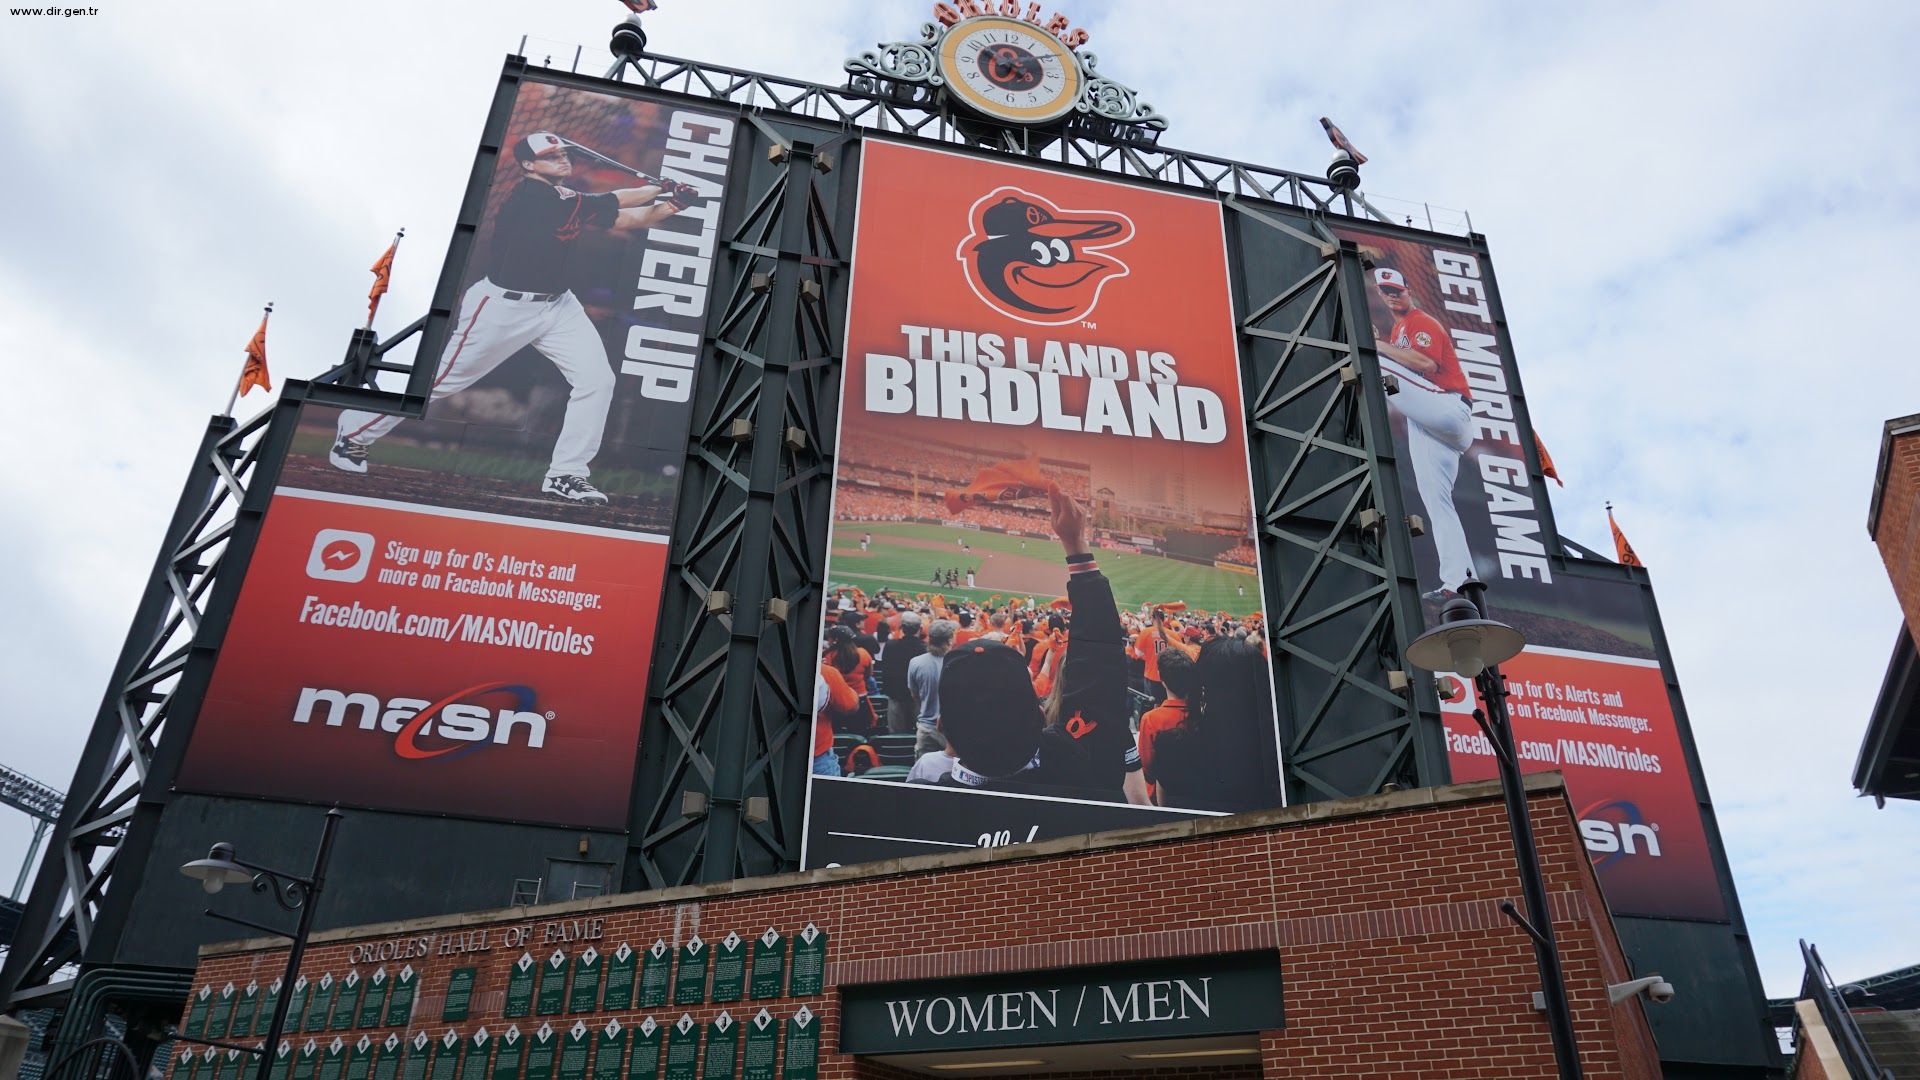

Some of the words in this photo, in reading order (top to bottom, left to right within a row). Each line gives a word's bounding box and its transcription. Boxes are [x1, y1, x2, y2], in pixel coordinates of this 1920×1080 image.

[933, 0, 1089, 49] ORIOLES
[633, 110, 735, 318] CHATTER
[1432, 248, 1493, 324] GET
[1081, 320, 1097, 329] TM
[620, 324, 700, 403] UP
[900, 324, 1006, 368] THIS
[1014, 336, 1130, 381] LAND
[1135, 350, 1179, 387] IS
[865, 352, 1228, 445] BIRDLAND
[1450, 327, 1521, 447] MORE
[1478, 453, 1553, 585] GAME
[377, 567, 419, 588] more
[421, 573, 441, 590] on
[444, 571, 516, 599] Facebook
[517, 580, 603, 612] Messenger.
[384, 540, 420, 566] Sign
[423, 549, 443, 569] up
[445, 548, 470, 569] for
[472, 551, 495, 572] O's
[497, 555, 546, 579] Alerts
[548, 563, 577, 583] and
[299, 595, 595, 656] Facebook.com/MASNOrioles
[292, 686, 548, 749] masn
[1508, 682, 1525, 700] up
[1525, 680, 1543, 699] for
[1545, 682, 1563, 701] O's
[1565, 684, 1601, 705] Alerts
[1602, 690, 1624, 708] and
[1517, 703, 1532, 718] on
[1533, 701, 1588, 725] Facebook
[1587, 707, 1653, 734] Messenger.
[349, 937, 429, 965] ORIOLES
[438, 930, 491, 956] HALL
[504, 925, 534, 948] OF
[544, 918, 605, 945] FAME
[885, 988, 1061, 1038] WOMEN
[1072, 986, 1087, 1027] /
[1098, 977, 1213, 1025] MEN
